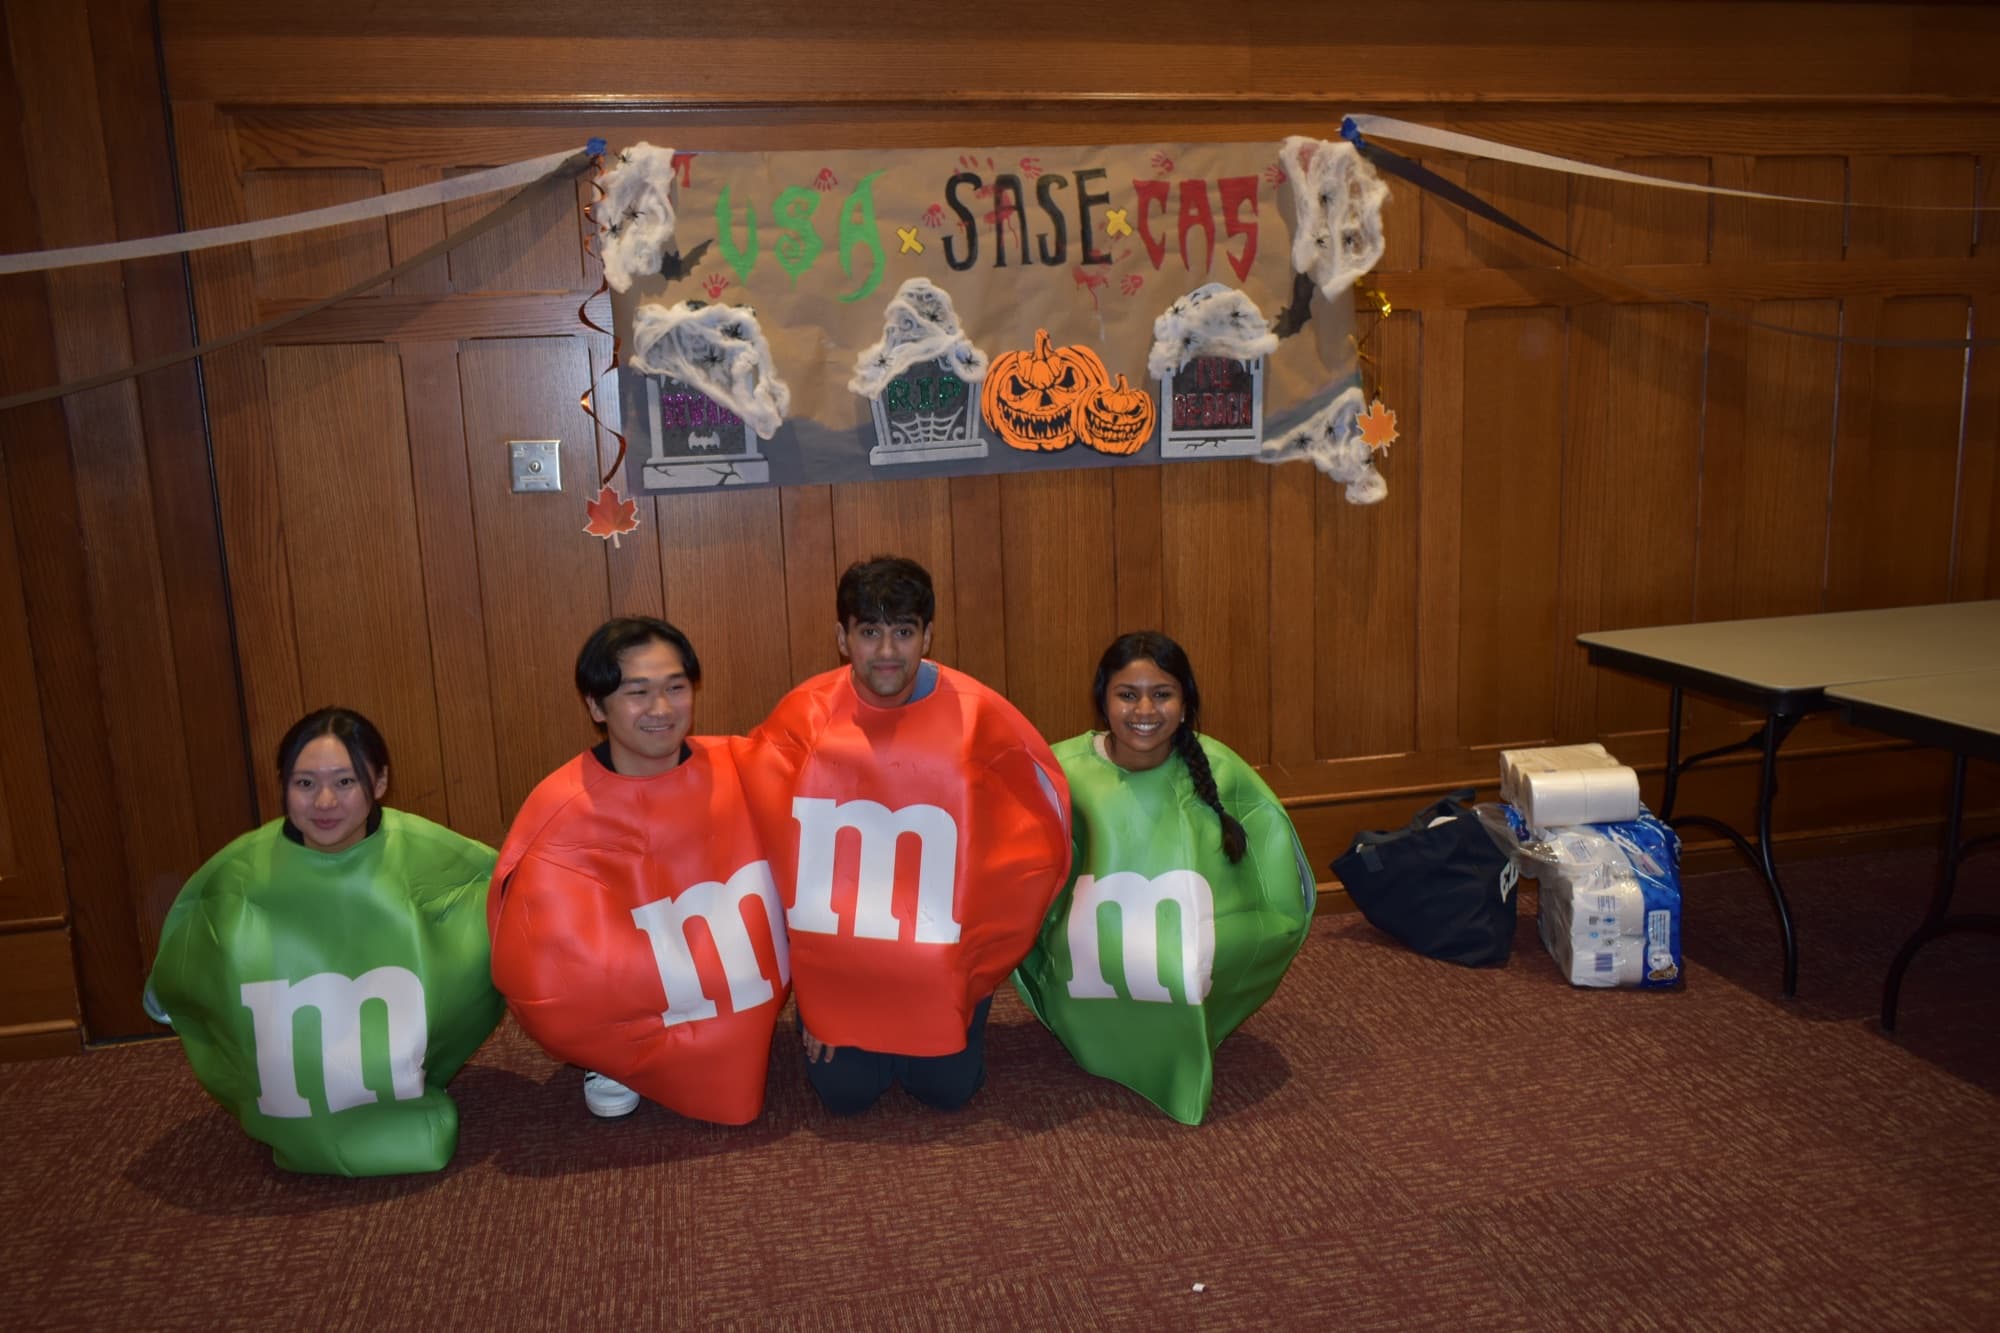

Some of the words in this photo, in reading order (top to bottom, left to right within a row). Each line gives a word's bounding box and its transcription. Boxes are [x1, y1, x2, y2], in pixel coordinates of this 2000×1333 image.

[716, 171, 886, 302] USA
[941, 168, 1113, 272] SASE
[1133, 175, 1259, 283] CAS
[887, 375, 962, 412] RIP
[788, 796, 961, 944] m
[1066, 870, 1216, 1005] m
[631, 860, 791, 1027] m
[240, 966, 428, 1118] m
